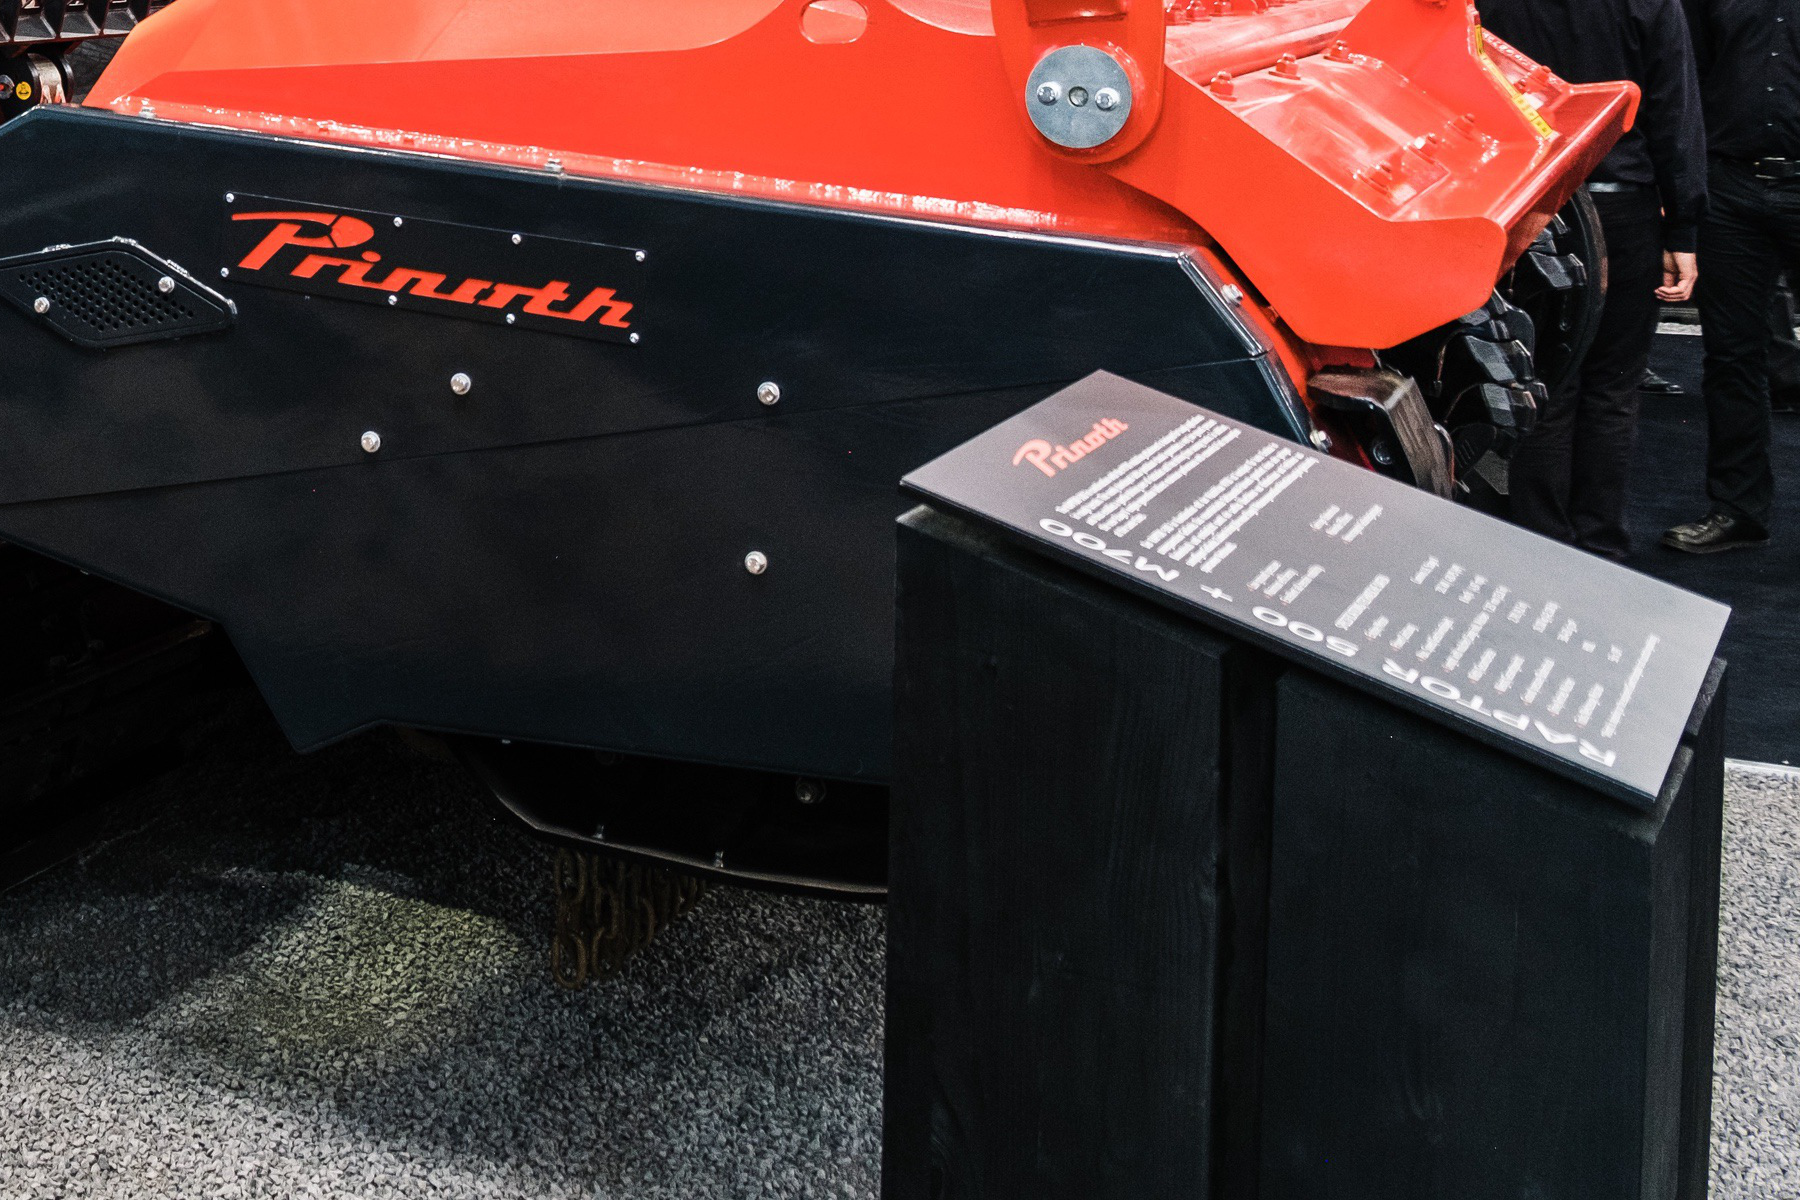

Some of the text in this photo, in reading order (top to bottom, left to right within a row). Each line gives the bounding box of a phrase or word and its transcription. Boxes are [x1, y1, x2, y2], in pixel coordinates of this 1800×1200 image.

[231, 211, 634, 329] Prinoth
[1012, 417, 1129, 478] Prinoth
[1039, 518, 1180, 582] M700
[1252, 606, 1359, 657] 500
[1382, 657, 1616, 767] RAPTOR
